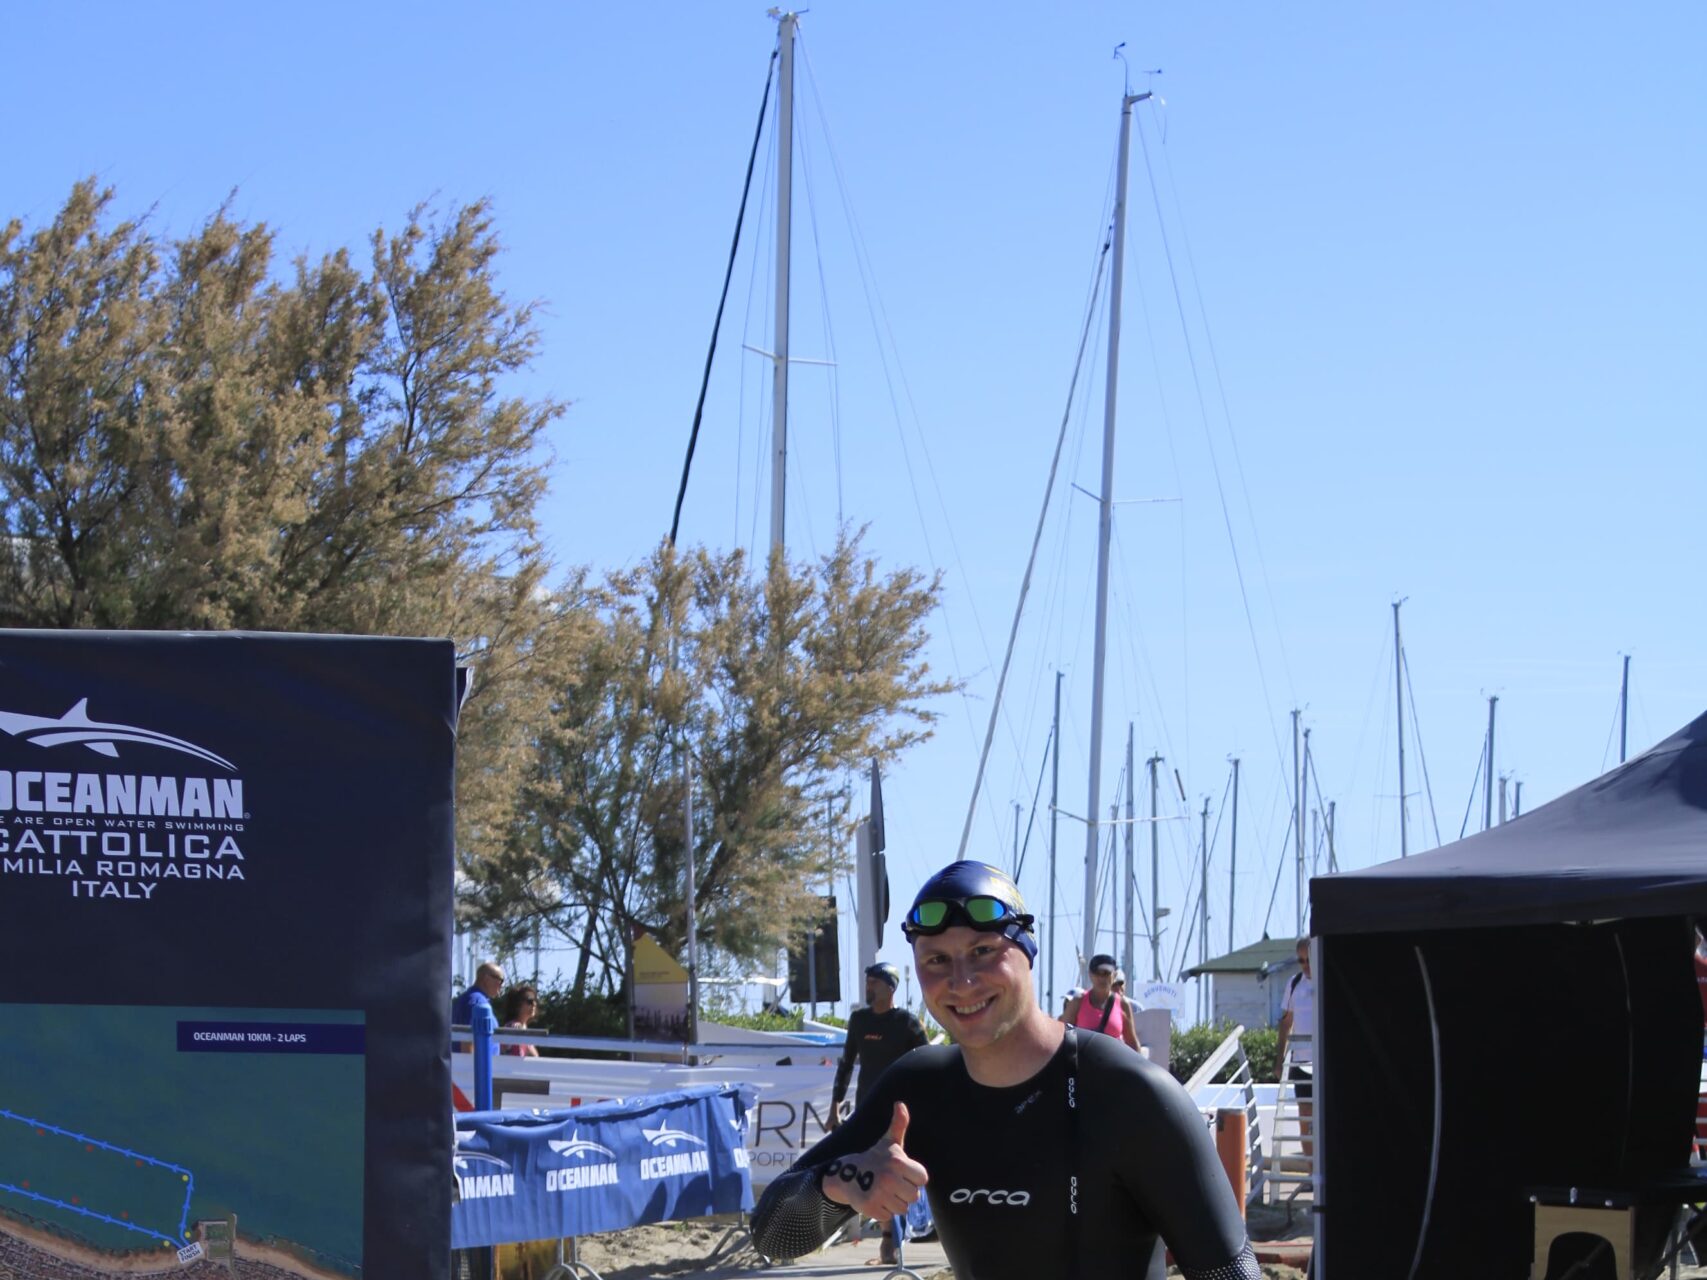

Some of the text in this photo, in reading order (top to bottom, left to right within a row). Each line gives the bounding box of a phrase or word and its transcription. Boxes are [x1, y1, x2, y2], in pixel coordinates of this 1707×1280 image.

[14, 816, 44, 825] ARE
[53, 817, 95, 826] OPEN
[104, 819, 156, 829] WATER
[165, 821, 244, 832] SWIMMING
[97, 861, 245, 880] ROMAGNA
[72, 880, 157, 899] ITALY
[193, 1031, 245, 1042] OCEANMAN
[247, 1032, 272, 1042] 10KM
[278, 1033, 284, 1042] 2
[285, 1033, 307, 1043] LAPS
[640, 1151, 709, 1180] OCEANMAN
[546, 1163, 619, 1192] OCEANMAN
[949, 1188, 1031, 1206] orca
[179, 1244, 197, 1256] START
